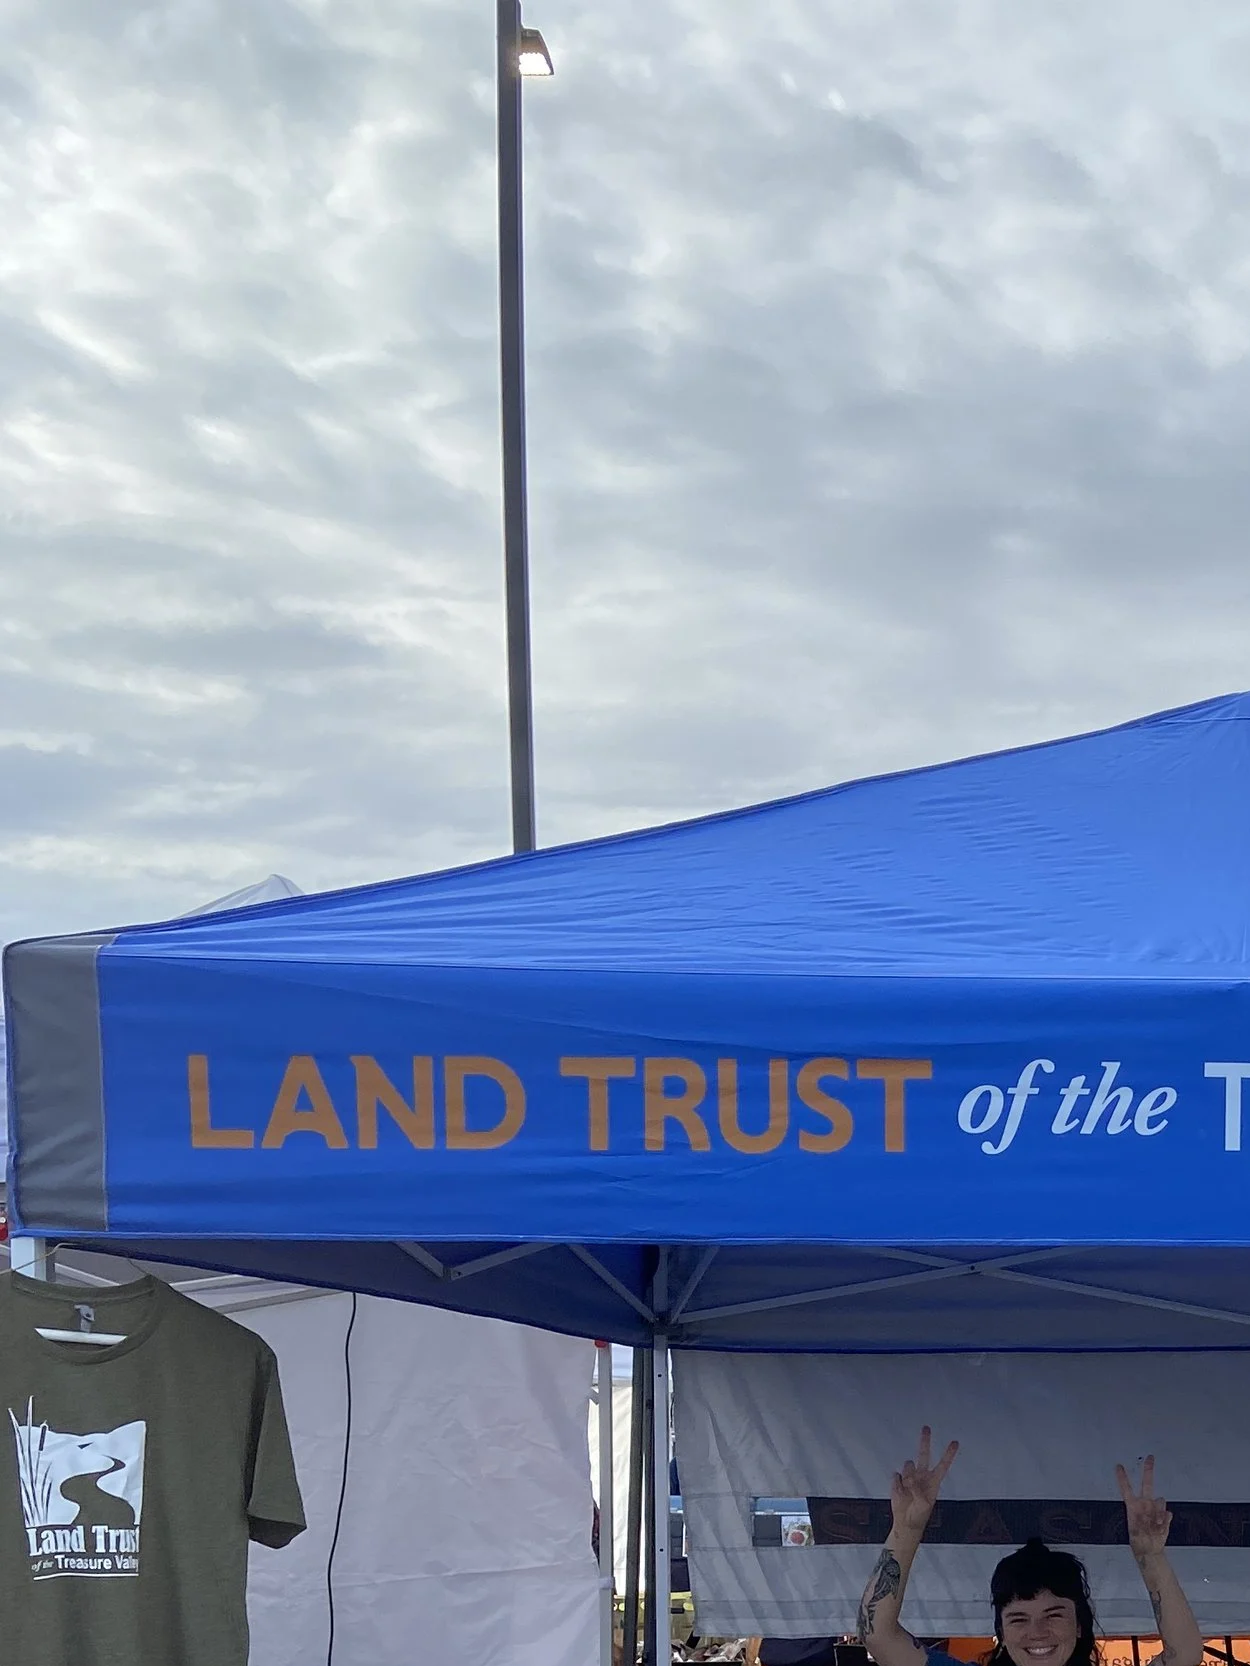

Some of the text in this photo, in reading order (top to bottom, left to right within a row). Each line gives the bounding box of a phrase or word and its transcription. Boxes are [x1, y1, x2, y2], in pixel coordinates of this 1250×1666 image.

[188, 1053, 527, 1150] LAND
[559, 1055, 933, 1155] TRUST
[957, 1057, 1056, 1156] of
[1056, 1060, 1177, 1137] the
[26, 1525, 140, 1557] Land Trust
[31, 1560, 43, 1572] of
[54, 1554, 112, 1570] Treasure
